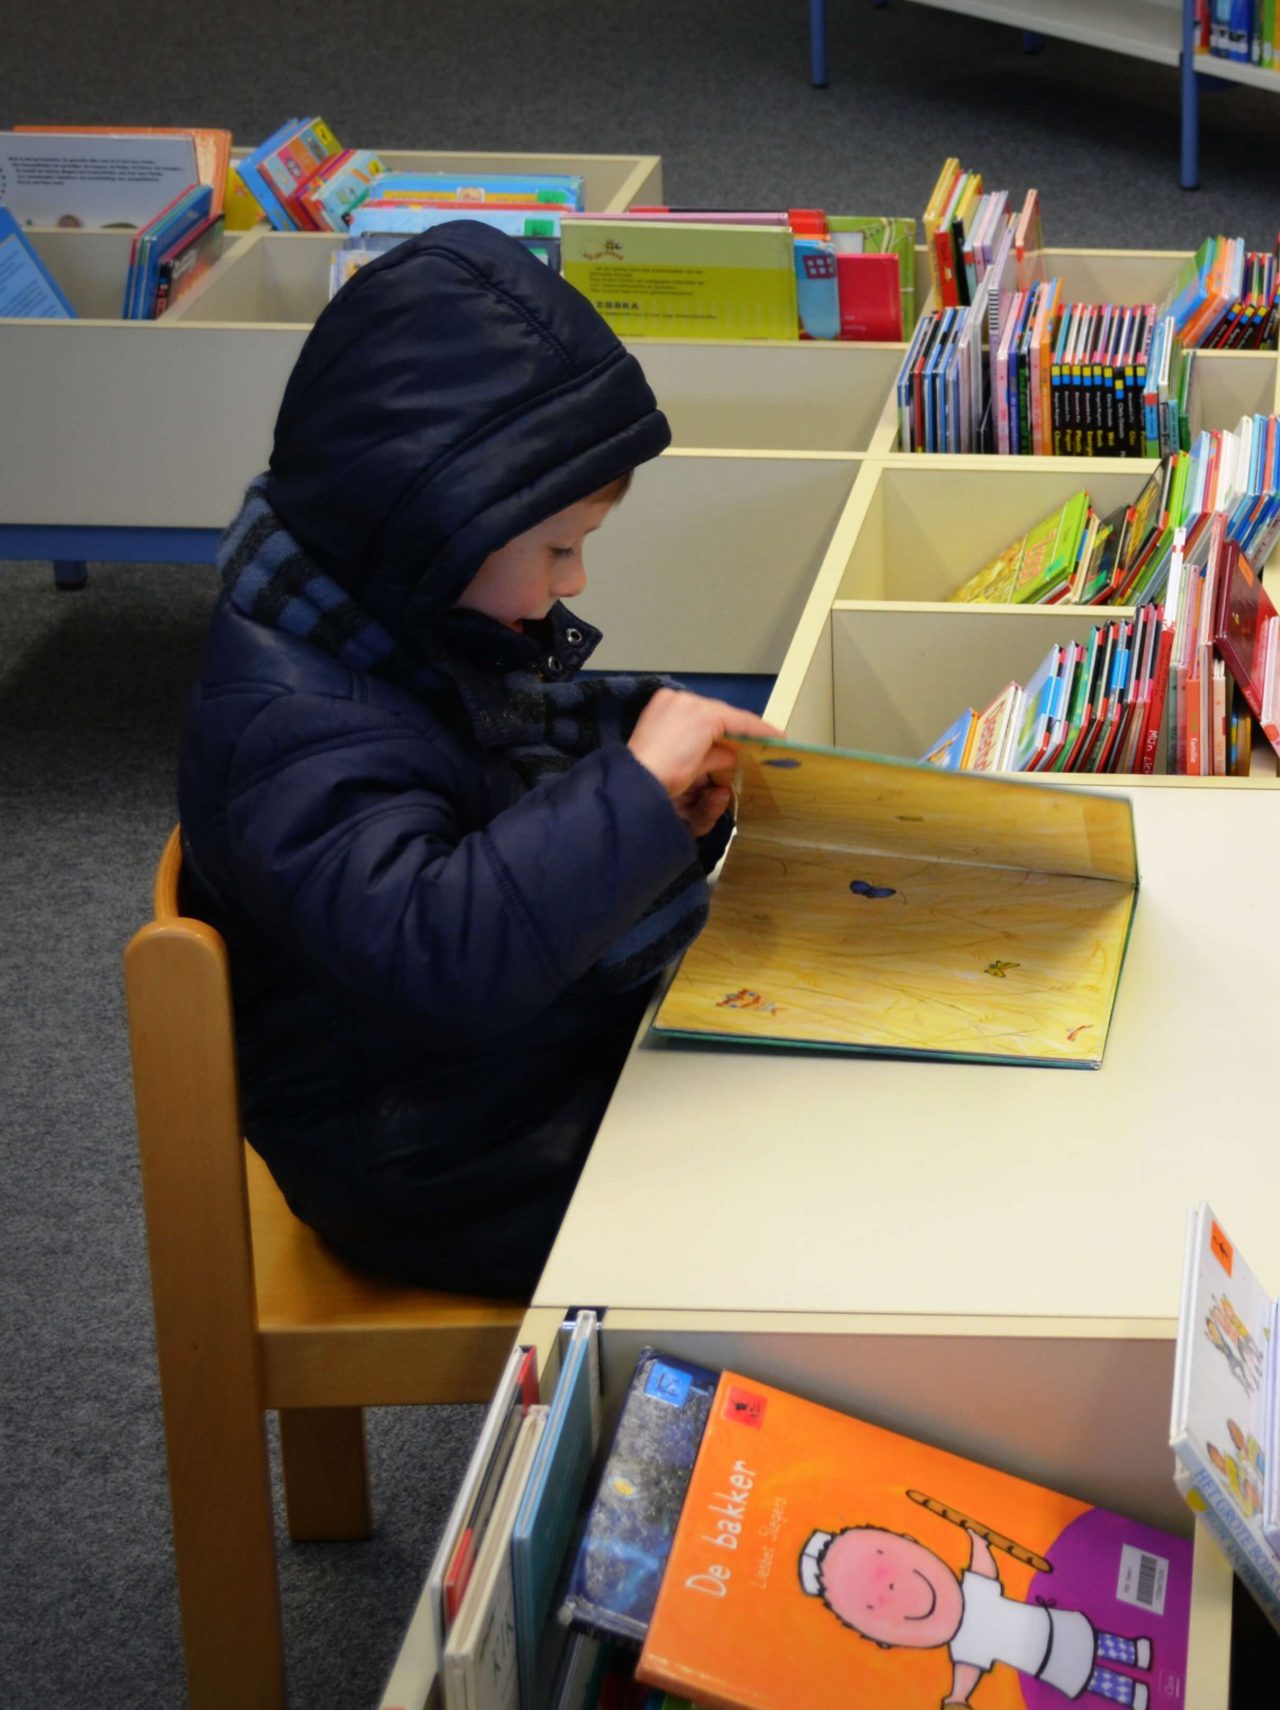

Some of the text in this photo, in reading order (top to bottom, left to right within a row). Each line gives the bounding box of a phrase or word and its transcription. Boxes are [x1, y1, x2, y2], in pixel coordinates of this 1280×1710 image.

[1190, 737, 1199, 763] familie
[684, 1459, 757, 1598] De bakker
[1194, 1467, 1220, 1507] HET
[1213, 1498, 1254, 1550] GROTE
